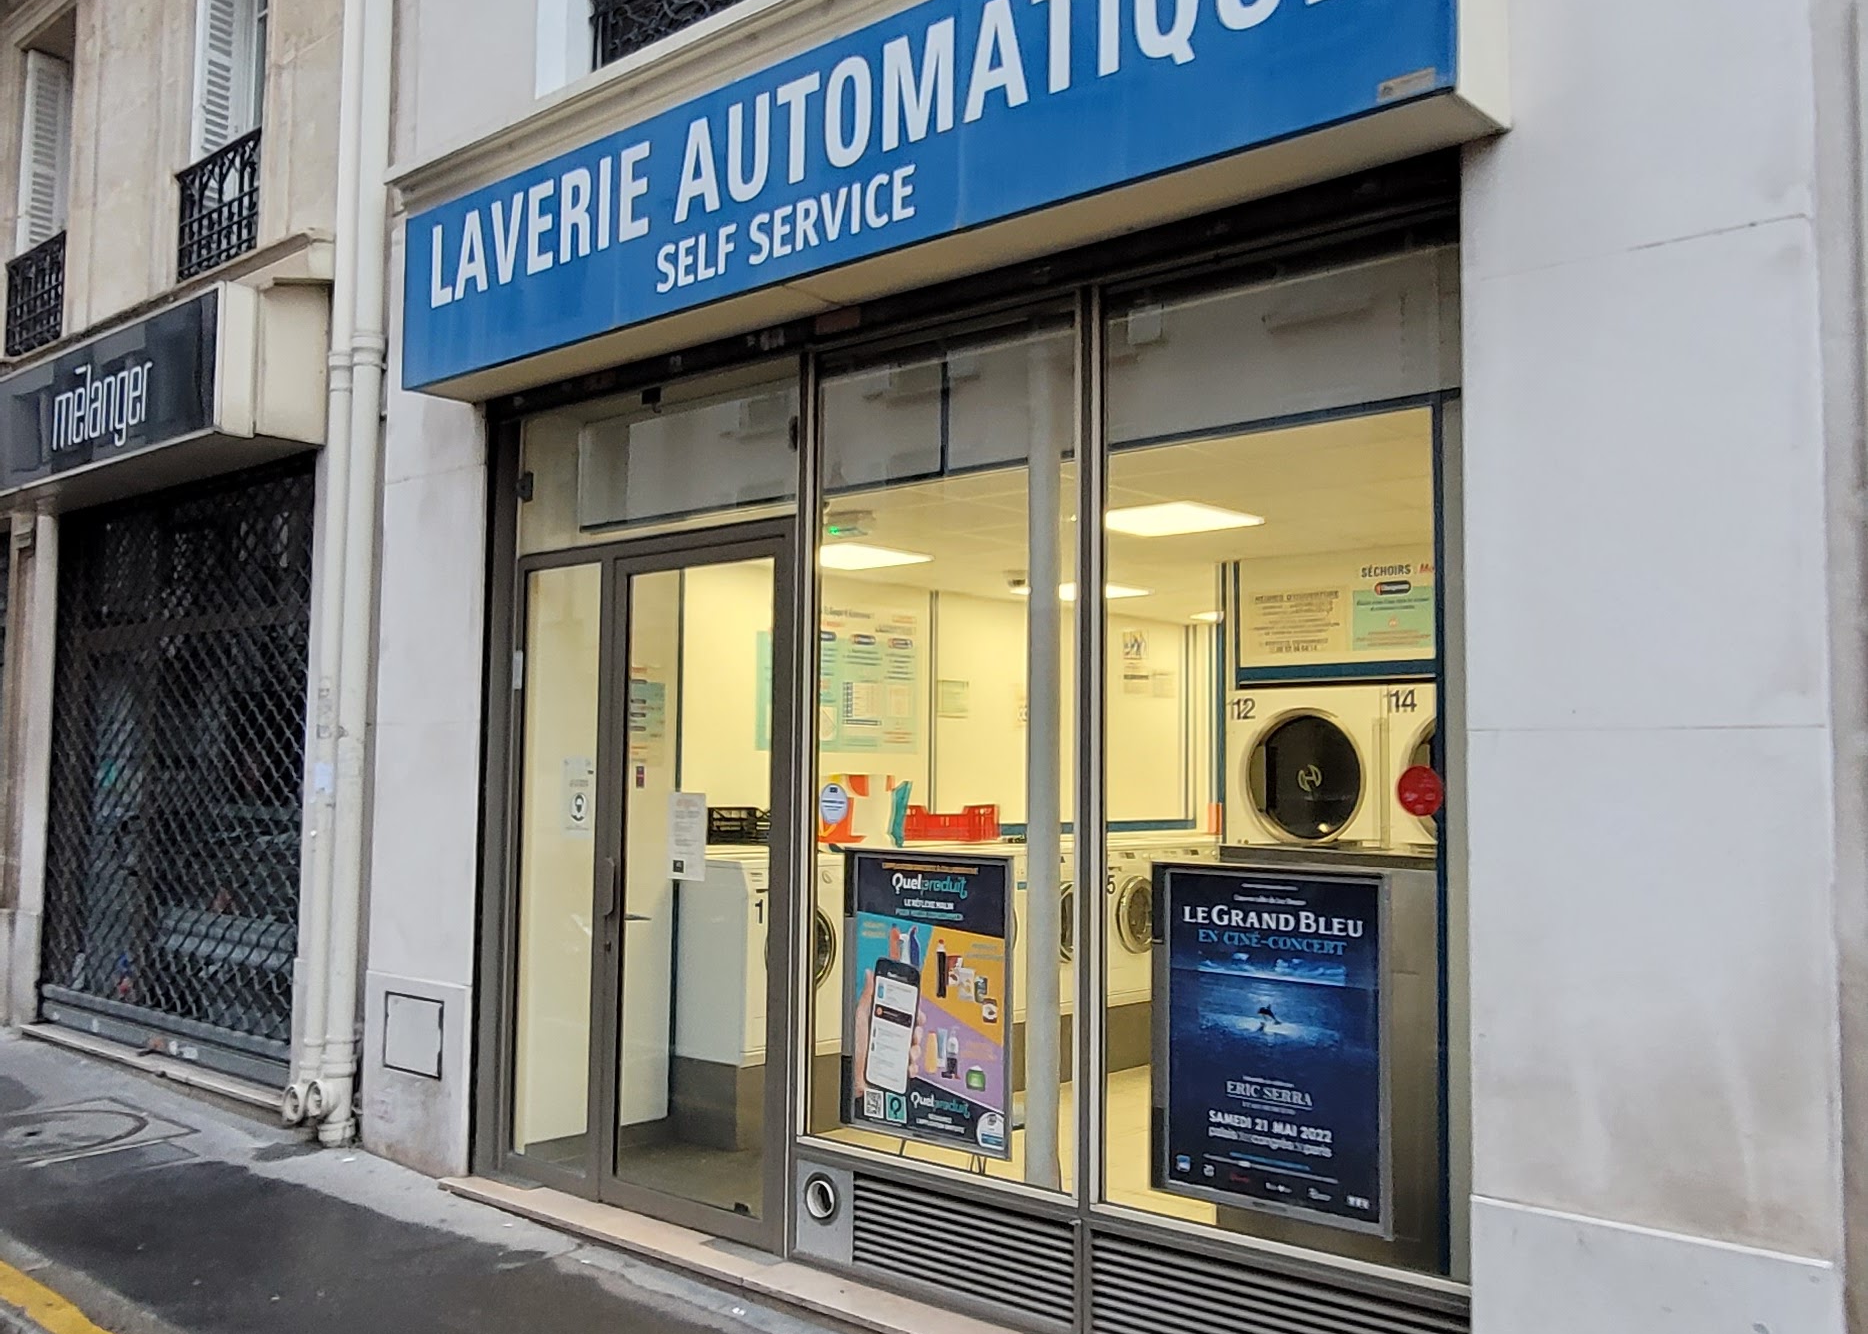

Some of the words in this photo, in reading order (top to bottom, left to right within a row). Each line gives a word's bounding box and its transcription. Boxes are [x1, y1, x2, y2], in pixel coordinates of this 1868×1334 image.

[430, 140, 650, 310] LAVERIE
[656, 231, 739, 294] SELF
[747, 163, 916, 264] SERVICE
[1361, 564, 1411, 578] SÉCHOIRS
[1232, 697, 1256, 719] 12
[1389, 689, 1417, 713] 14
[1183, 906, 1210, 924] LE
[1211, 905, 1295, 931] GRAND
[1298, 911, 1364, 937] BLEU
[1198, 929, 1218, 942] EN
[1223, 931, 1347, 956] CINÉ-CONCERT
[1226, 1081, 1260, 1097] ERIC
[1263, 1086, 1313, 1106] SERRA
[1209, 1110, 1251, 1129] SAMEDI
[1254, 1118, 1269, 1131] 21
[1272, 1121, 1297, 1137] MAI
[1300, 1126, 1333, 1143] 2022
